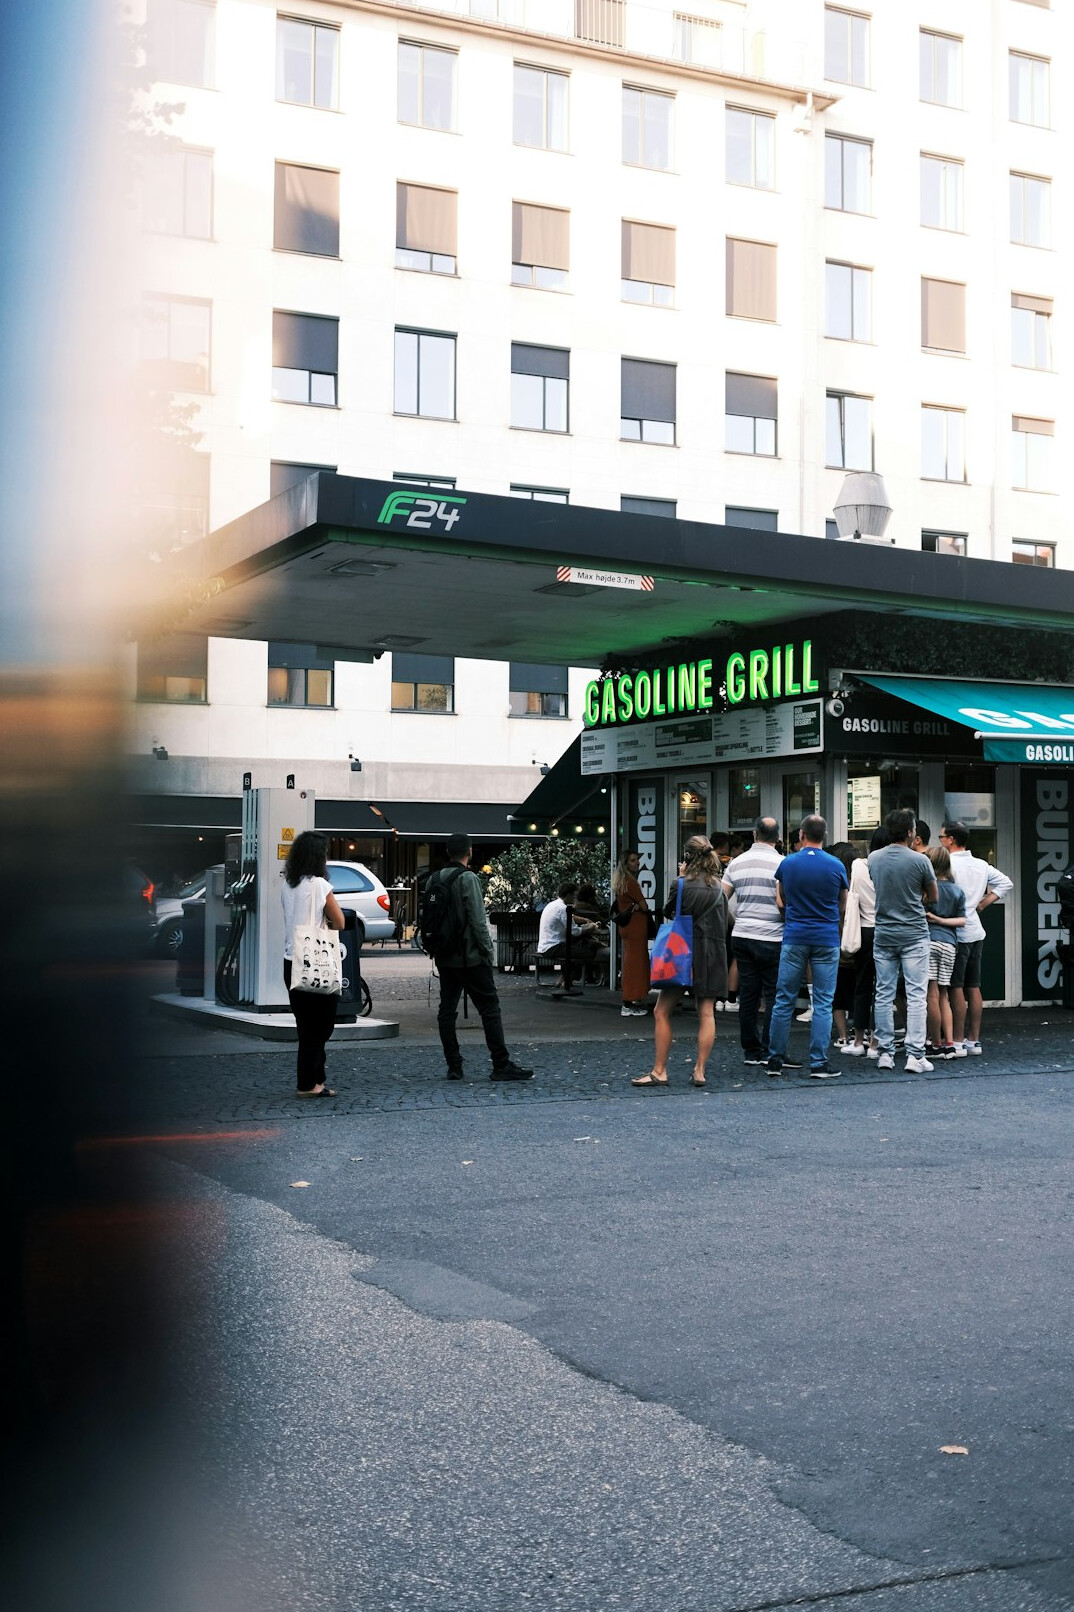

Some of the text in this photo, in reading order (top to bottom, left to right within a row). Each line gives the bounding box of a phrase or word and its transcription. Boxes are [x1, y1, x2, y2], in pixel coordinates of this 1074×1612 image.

[377, 490, 467, 531] F24
[577, 571, 635, 585] Max højde 3.7m
[585, 639, 819, 727] GASOLINE GRILL
[842, 717, 950, 736] GASOLINE GRILL
[244, 778, 250, 786] B
[1036, 780, 1070, 989] BURGERS
